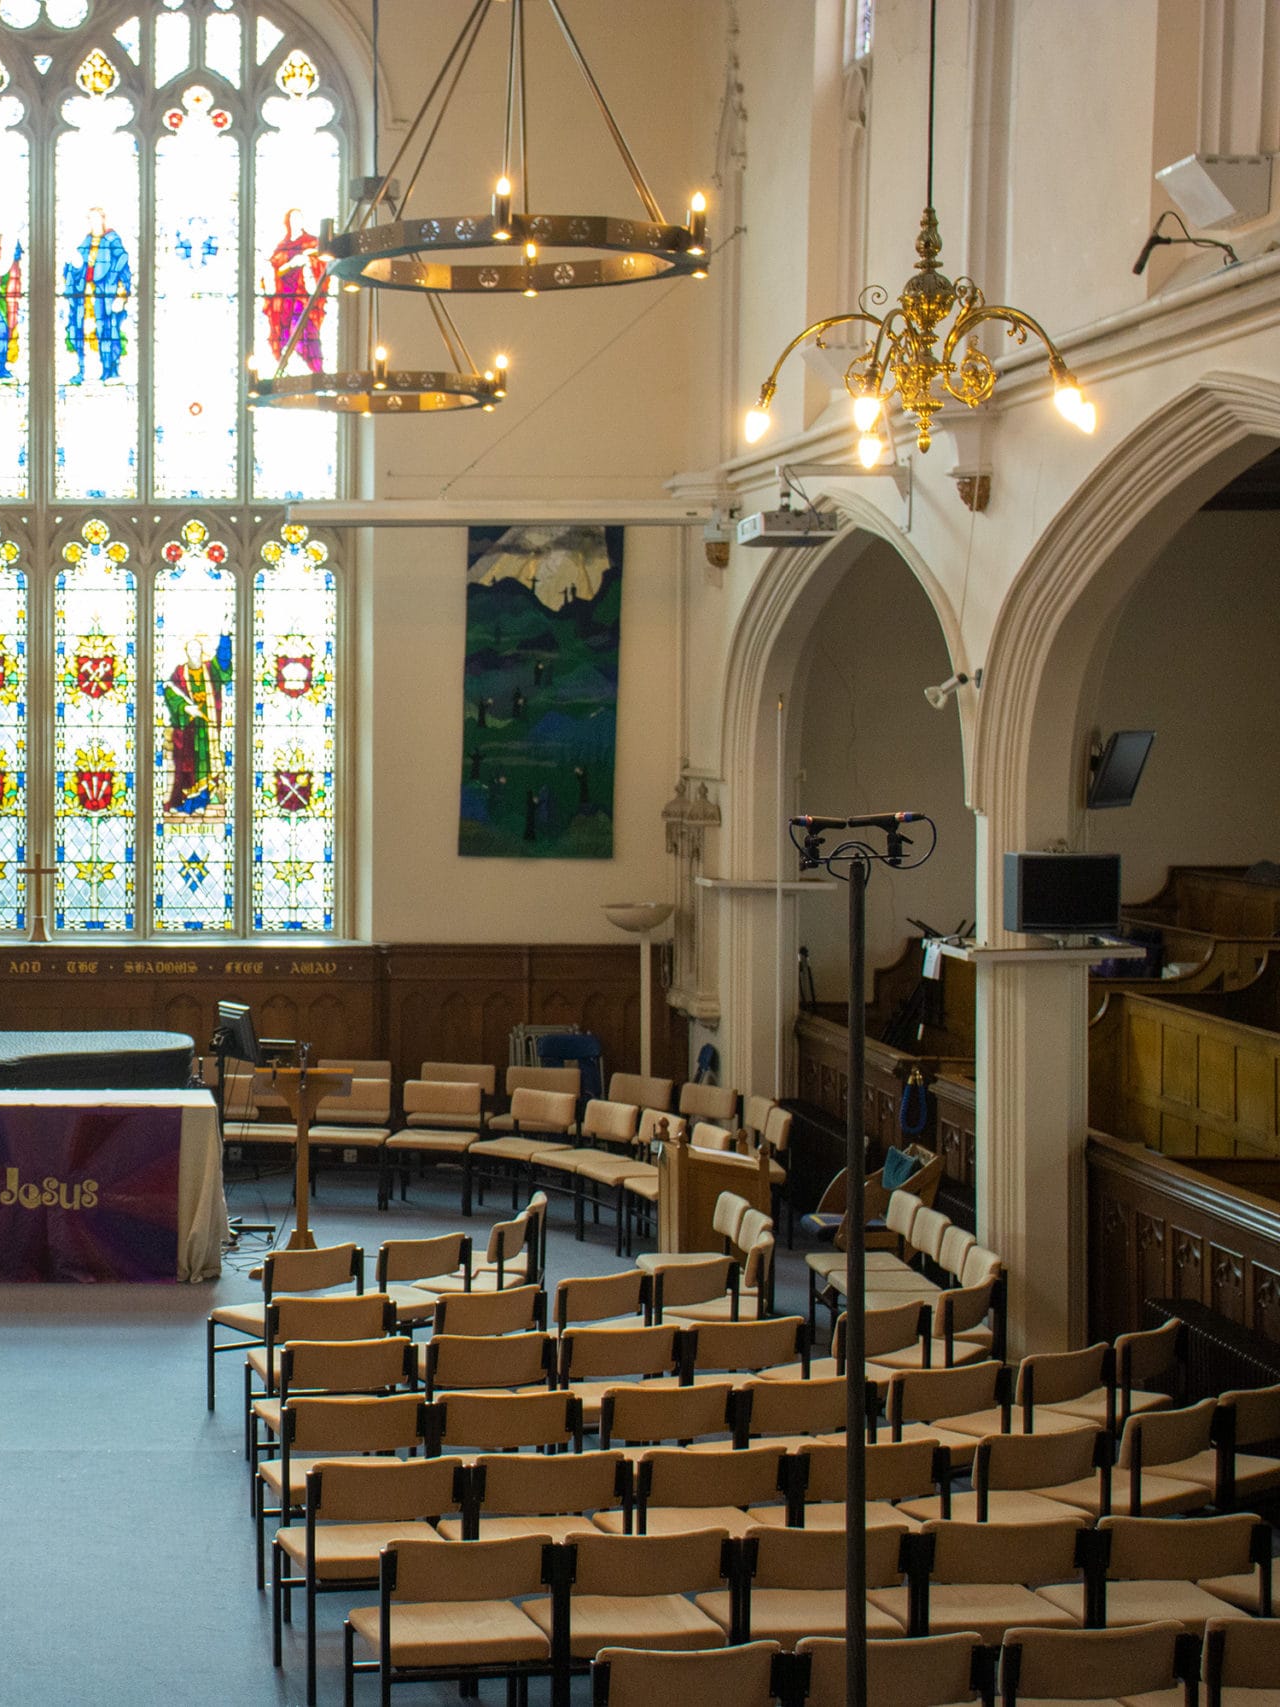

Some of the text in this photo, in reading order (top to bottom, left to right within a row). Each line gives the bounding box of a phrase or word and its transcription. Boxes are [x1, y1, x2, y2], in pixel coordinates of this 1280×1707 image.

[9, 961, 42, 973] AND
[67, 961, 99, 973] THE
[124, 961, 199, 974] SHADOWS
[224, 961, 264, 974] FLEE
[290, 961, 337, 975] AWAY
[0, 1167, 99, 1210] Jesus
